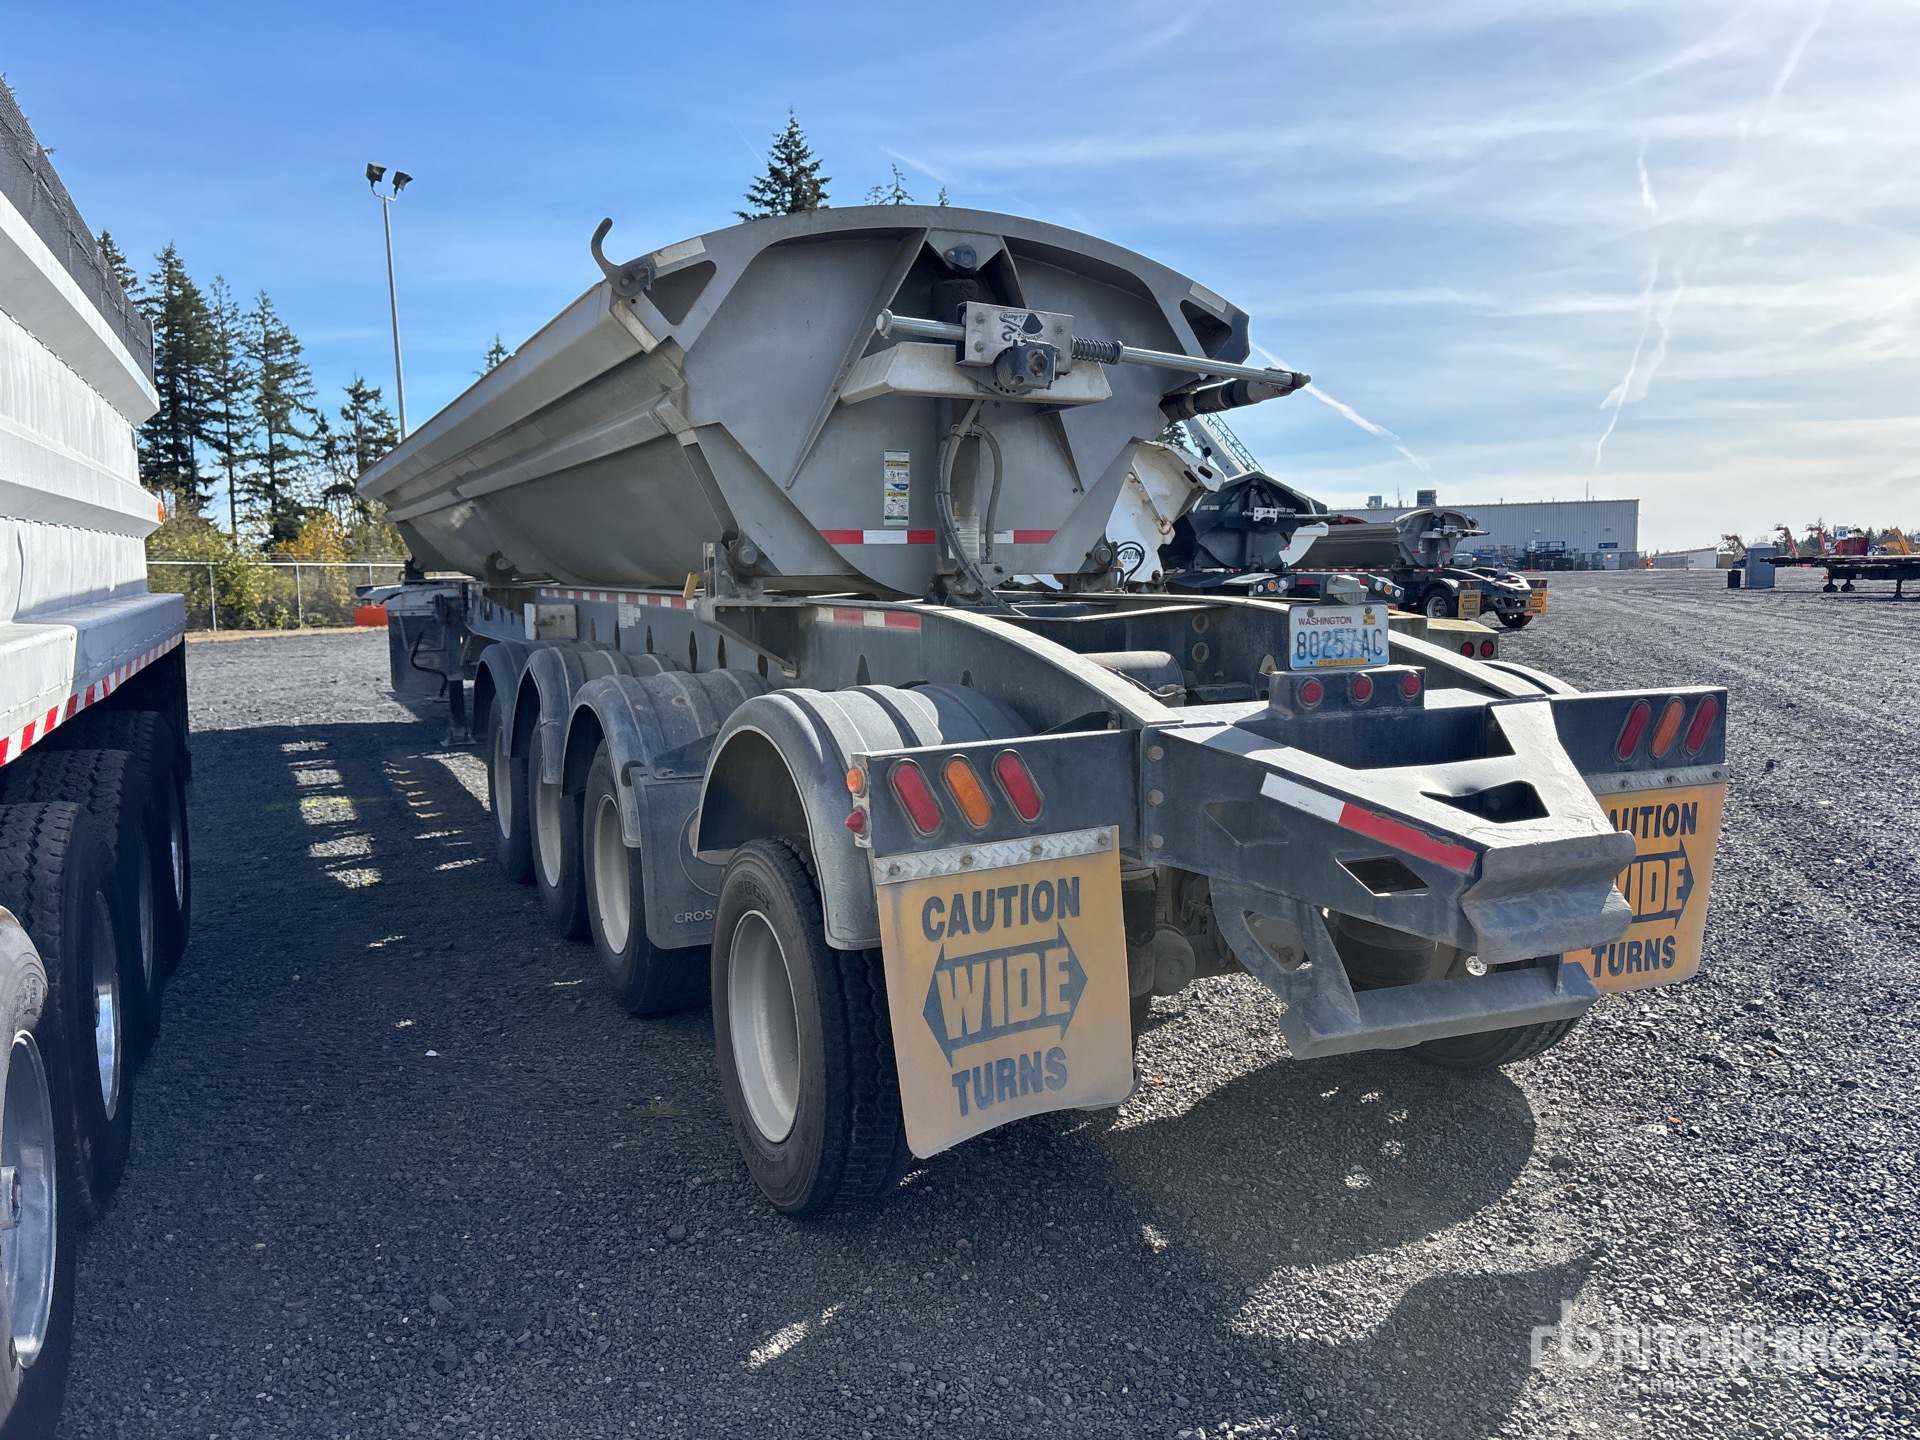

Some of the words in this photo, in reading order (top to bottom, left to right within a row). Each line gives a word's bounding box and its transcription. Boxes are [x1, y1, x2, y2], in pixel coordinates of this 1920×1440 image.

[1298, 616, 1352, 626] WASHINGTON
[1296, 628, 1383, 660] 80257AC
[1609, 801, 1698, 839] AUTION
[921, 876, 1081, 943] CAUTION
[1591, 935, 1676, 978] TURNS
[934, 946, 1071, 1041] WIDE
[951, 1046, 1068, 1117] TURNS
